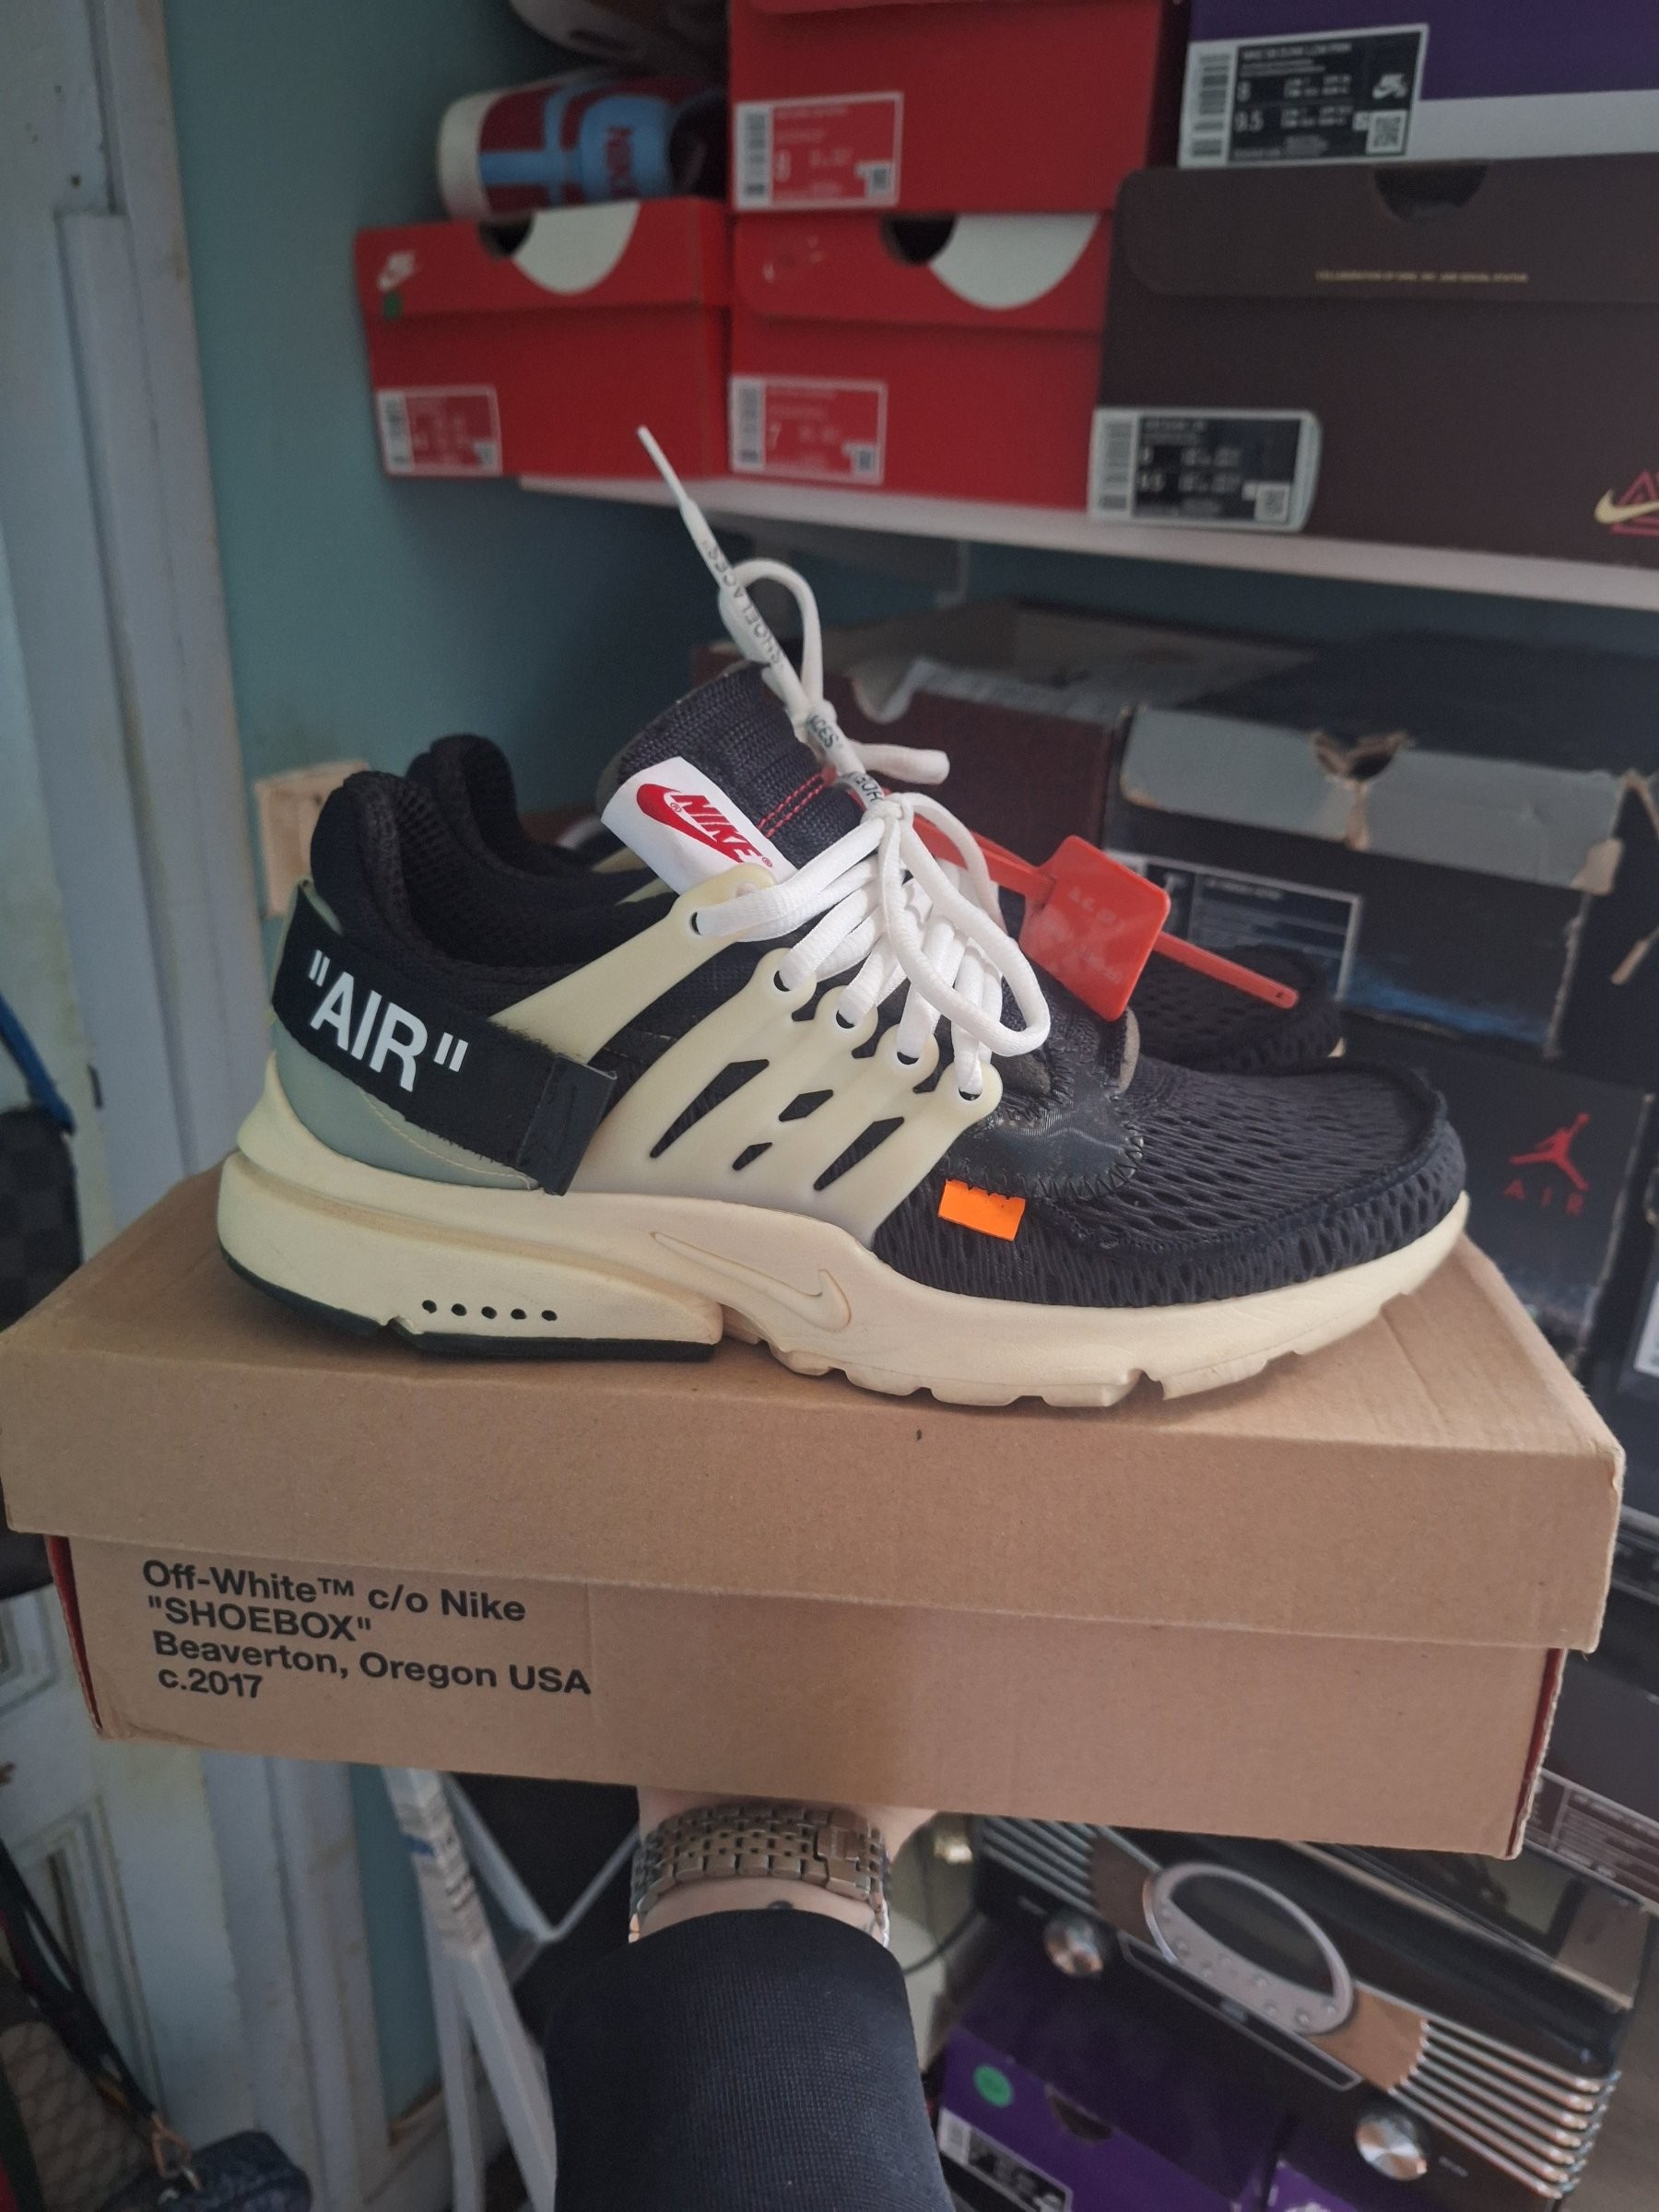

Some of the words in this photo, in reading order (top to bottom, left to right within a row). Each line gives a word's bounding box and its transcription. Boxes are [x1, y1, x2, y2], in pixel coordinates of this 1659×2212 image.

[308, 949, 469, 1093] "AIR"
[1503, 1178, 1584, 1216] AIR
[148, 1595, 371, 1641] "SHOEBOX"
[368, 1584, 429, 1615] c/o
[441, 1588, 525, 1621] Nike
[153, 1630, 348, 1679] Beaverton,
[360, 1652, 498, 1689] Oregon
[509, 1665, 592, 1695] USA
[159, 1668, 262, 1699] c.2017
